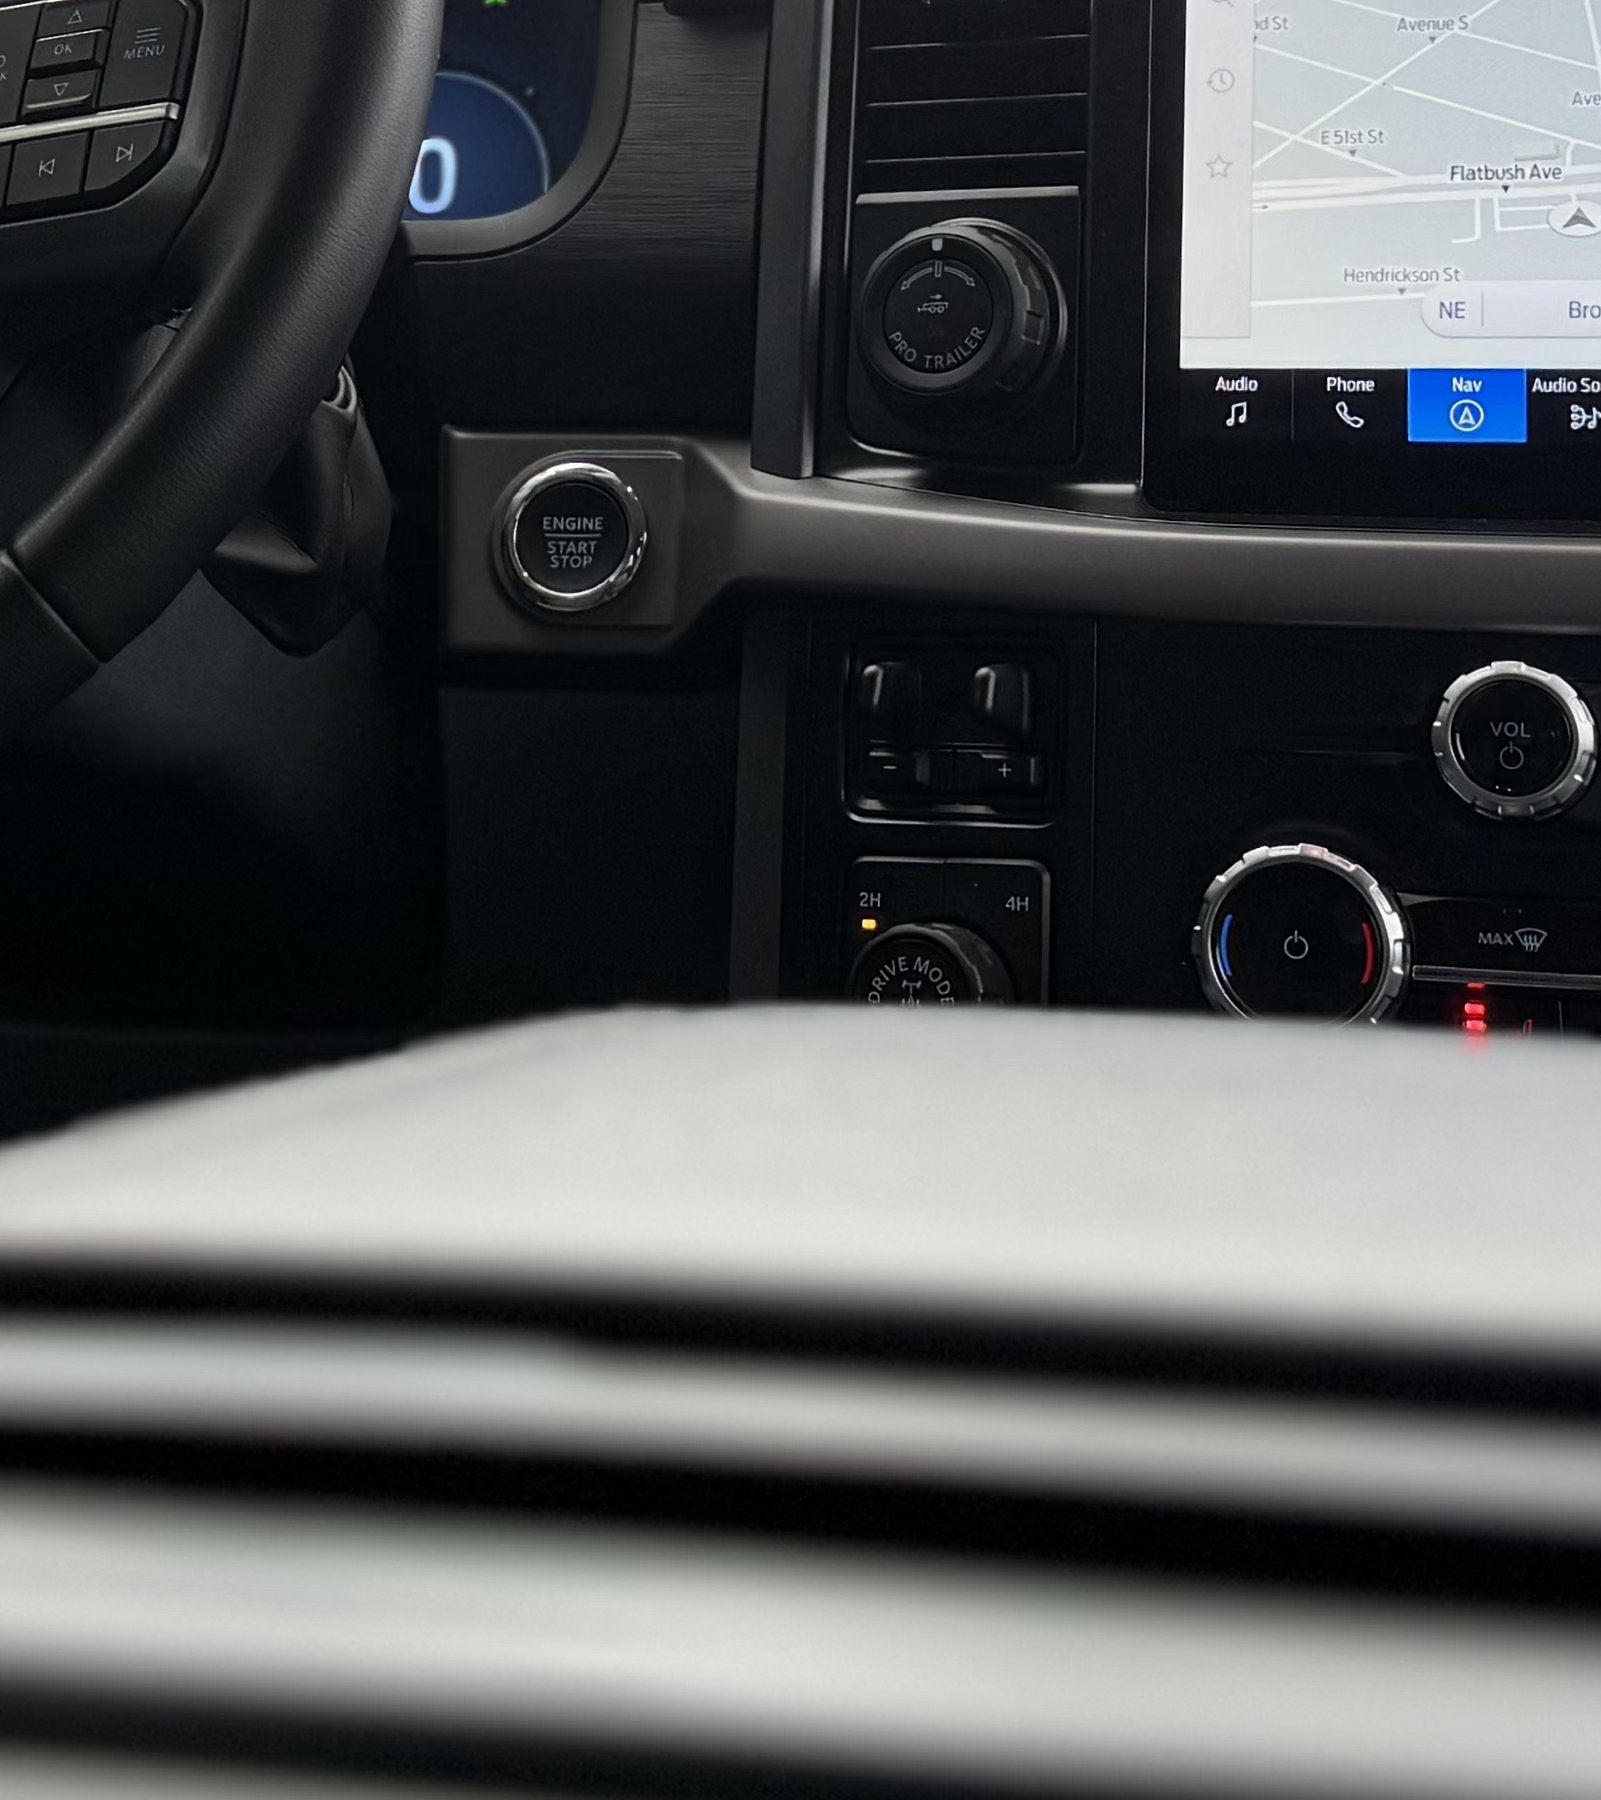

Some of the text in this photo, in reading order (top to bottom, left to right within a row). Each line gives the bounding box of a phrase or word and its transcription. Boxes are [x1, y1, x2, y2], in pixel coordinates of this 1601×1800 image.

[1273, 16, 1288, 30] St
[1397, 15, 1469, 31] Avenue S
[55, 44, 72, 54] OK
[124, 45, 165, 59] MENU
[1321, 130, 1384, 144] E 51st St
[409, 137, 457, 214] 0
[1450, 163, 1562, 181] Flatbush Ave
[1344, 268, 1460, 283] Hendrickson St
[1439, 302, 1466, 319] NE
[888, 327, 985, 368] PRO TRAILER
[1215, 377, 1258, 391] Audio
[1327, 377, 1375, 391] Phone
[1452, 377, 1482, 392] Nav
[1532, 378, 1576, 393] Audio
[543, 517, 603, 530] ENGINE
[548, 541, 597, 553] START
[550, 555, 592, 568] STOP
[1490, 721, 1531, 738] VOL
[859, 892, 881, 907] 2H
[1005, 897, 1029, 911] 4H
[1479, 931, 1513, 946] MAX
[868, 956, 909, 1004] DRIVE
